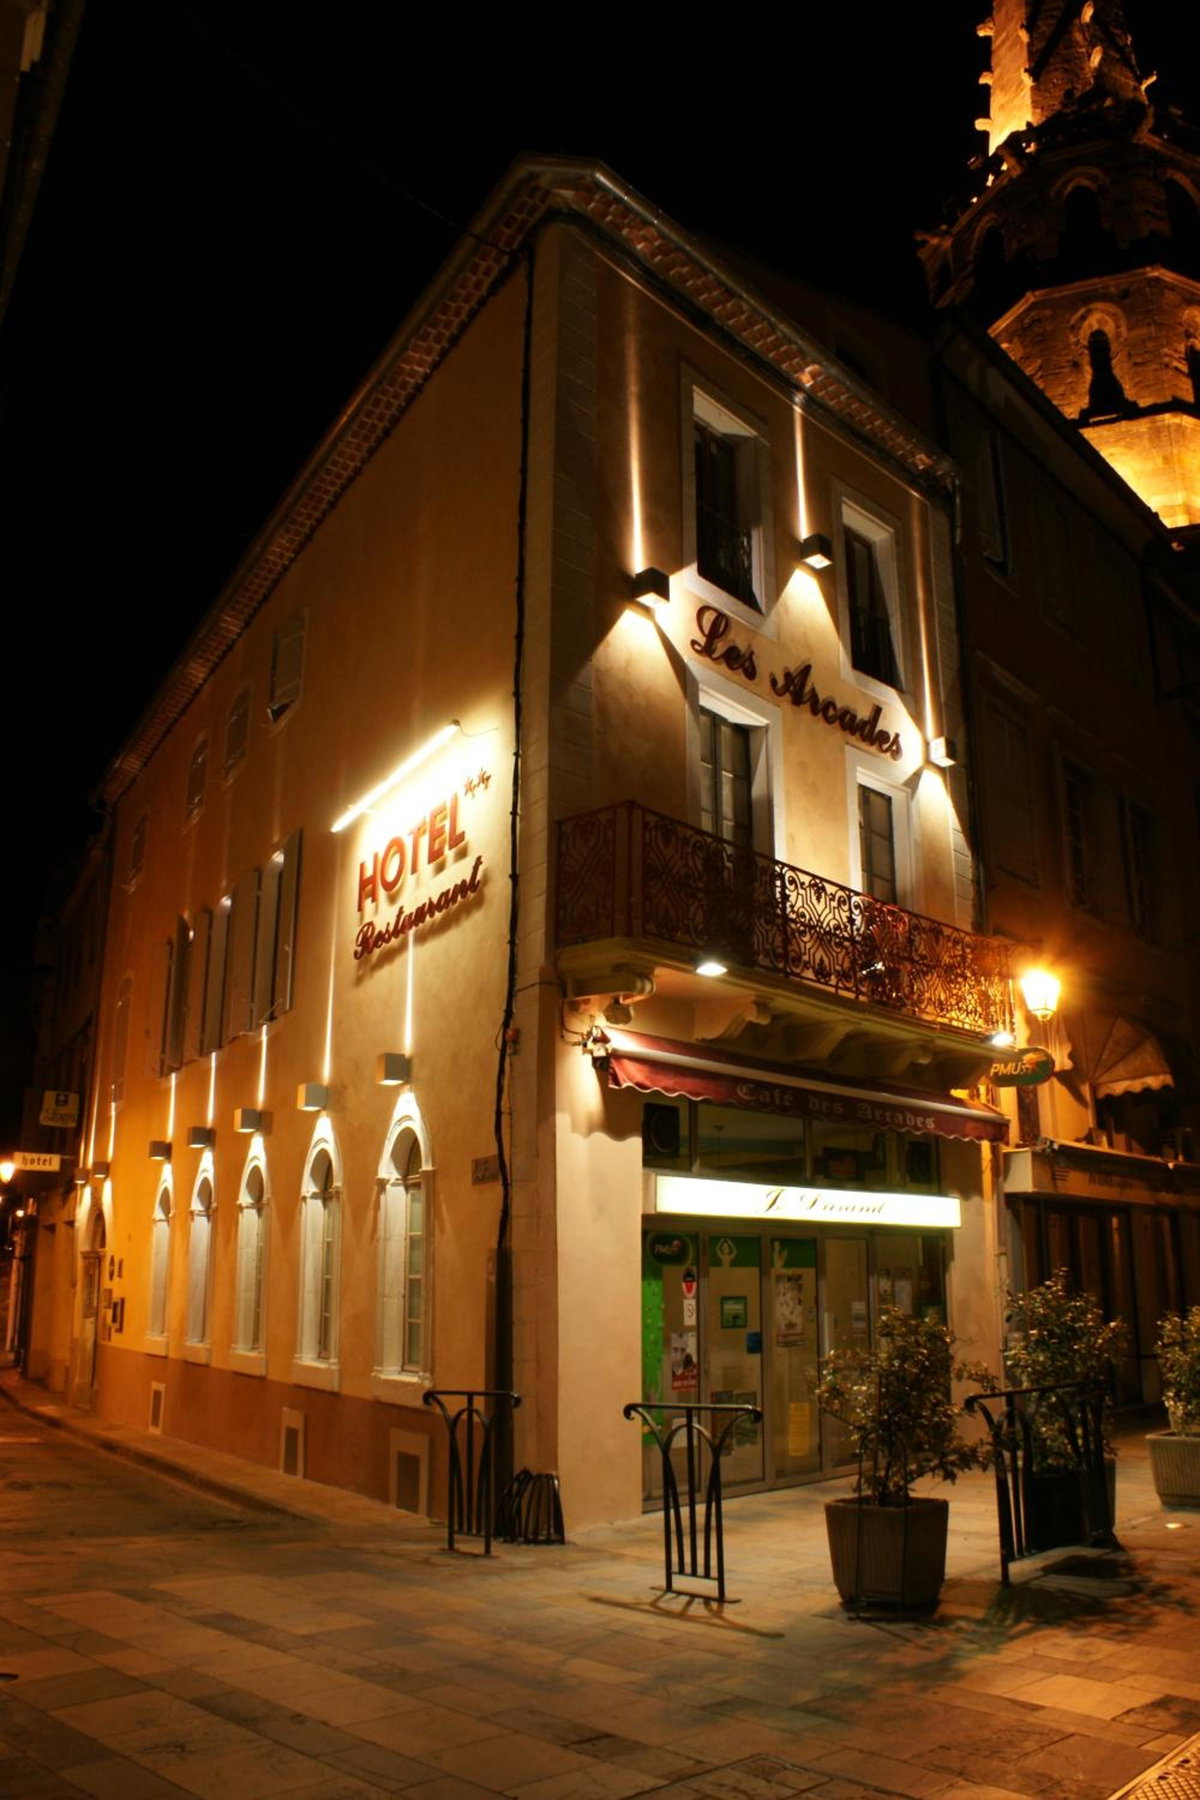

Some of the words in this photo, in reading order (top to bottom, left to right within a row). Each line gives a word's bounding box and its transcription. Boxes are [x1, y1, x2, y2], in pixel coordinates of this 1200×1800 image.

[690, 605, 757, 681] Les
[769, 663, 903, 762] Arcades
[356, 793, 466, 913] HOTEL
[353, 855, 484, 961] Restaurant
[990, 1062, 1023, 1077] PMU
[856, 1101, 936, 1130] Arcades
[22, 1154, 53, 1168] hotel
